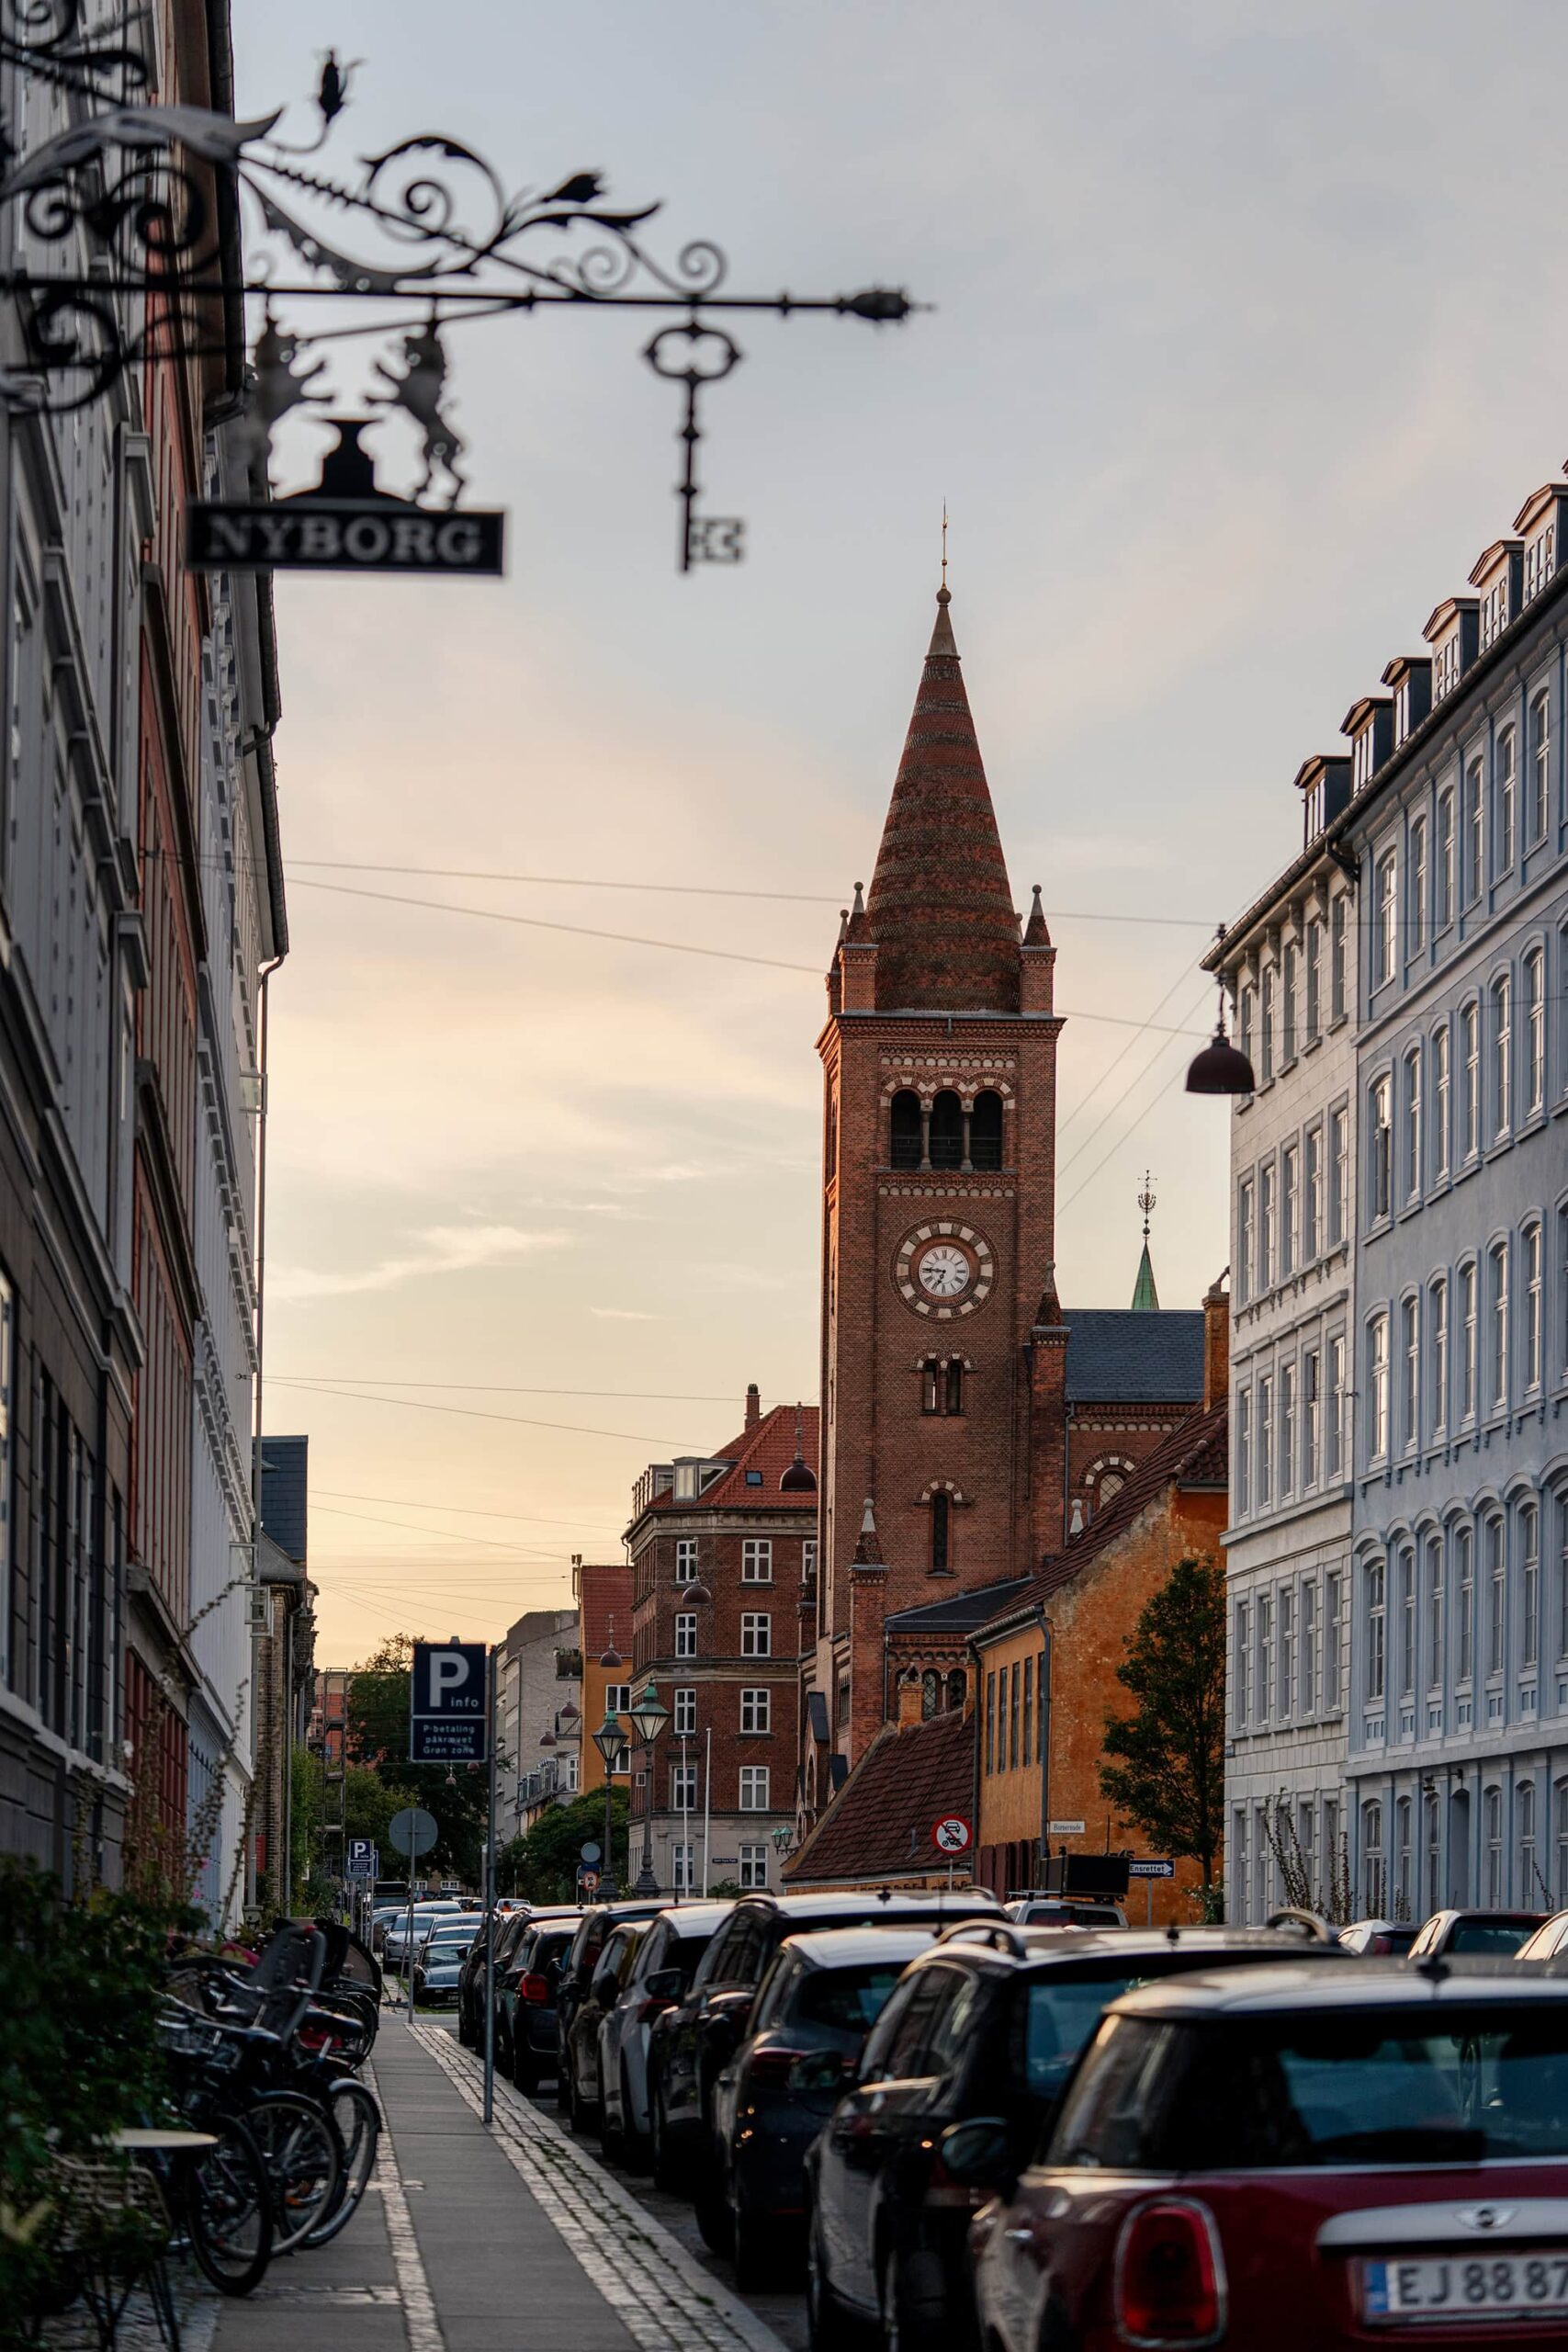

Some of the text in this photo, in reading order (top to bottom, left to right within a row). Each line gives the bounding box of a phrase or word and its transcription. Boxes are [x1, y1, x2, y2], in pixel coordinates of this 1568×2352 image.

[209, 514, 481, 562] NYBORG
[429, 1652, 469, 1707] P
[450, 1697, 479, 1707] info
[423, 1724, 475, 1735] P-betaling
[423, 1746, 446, 1754] Grøn
[354, 1842, 367, 1859] P
